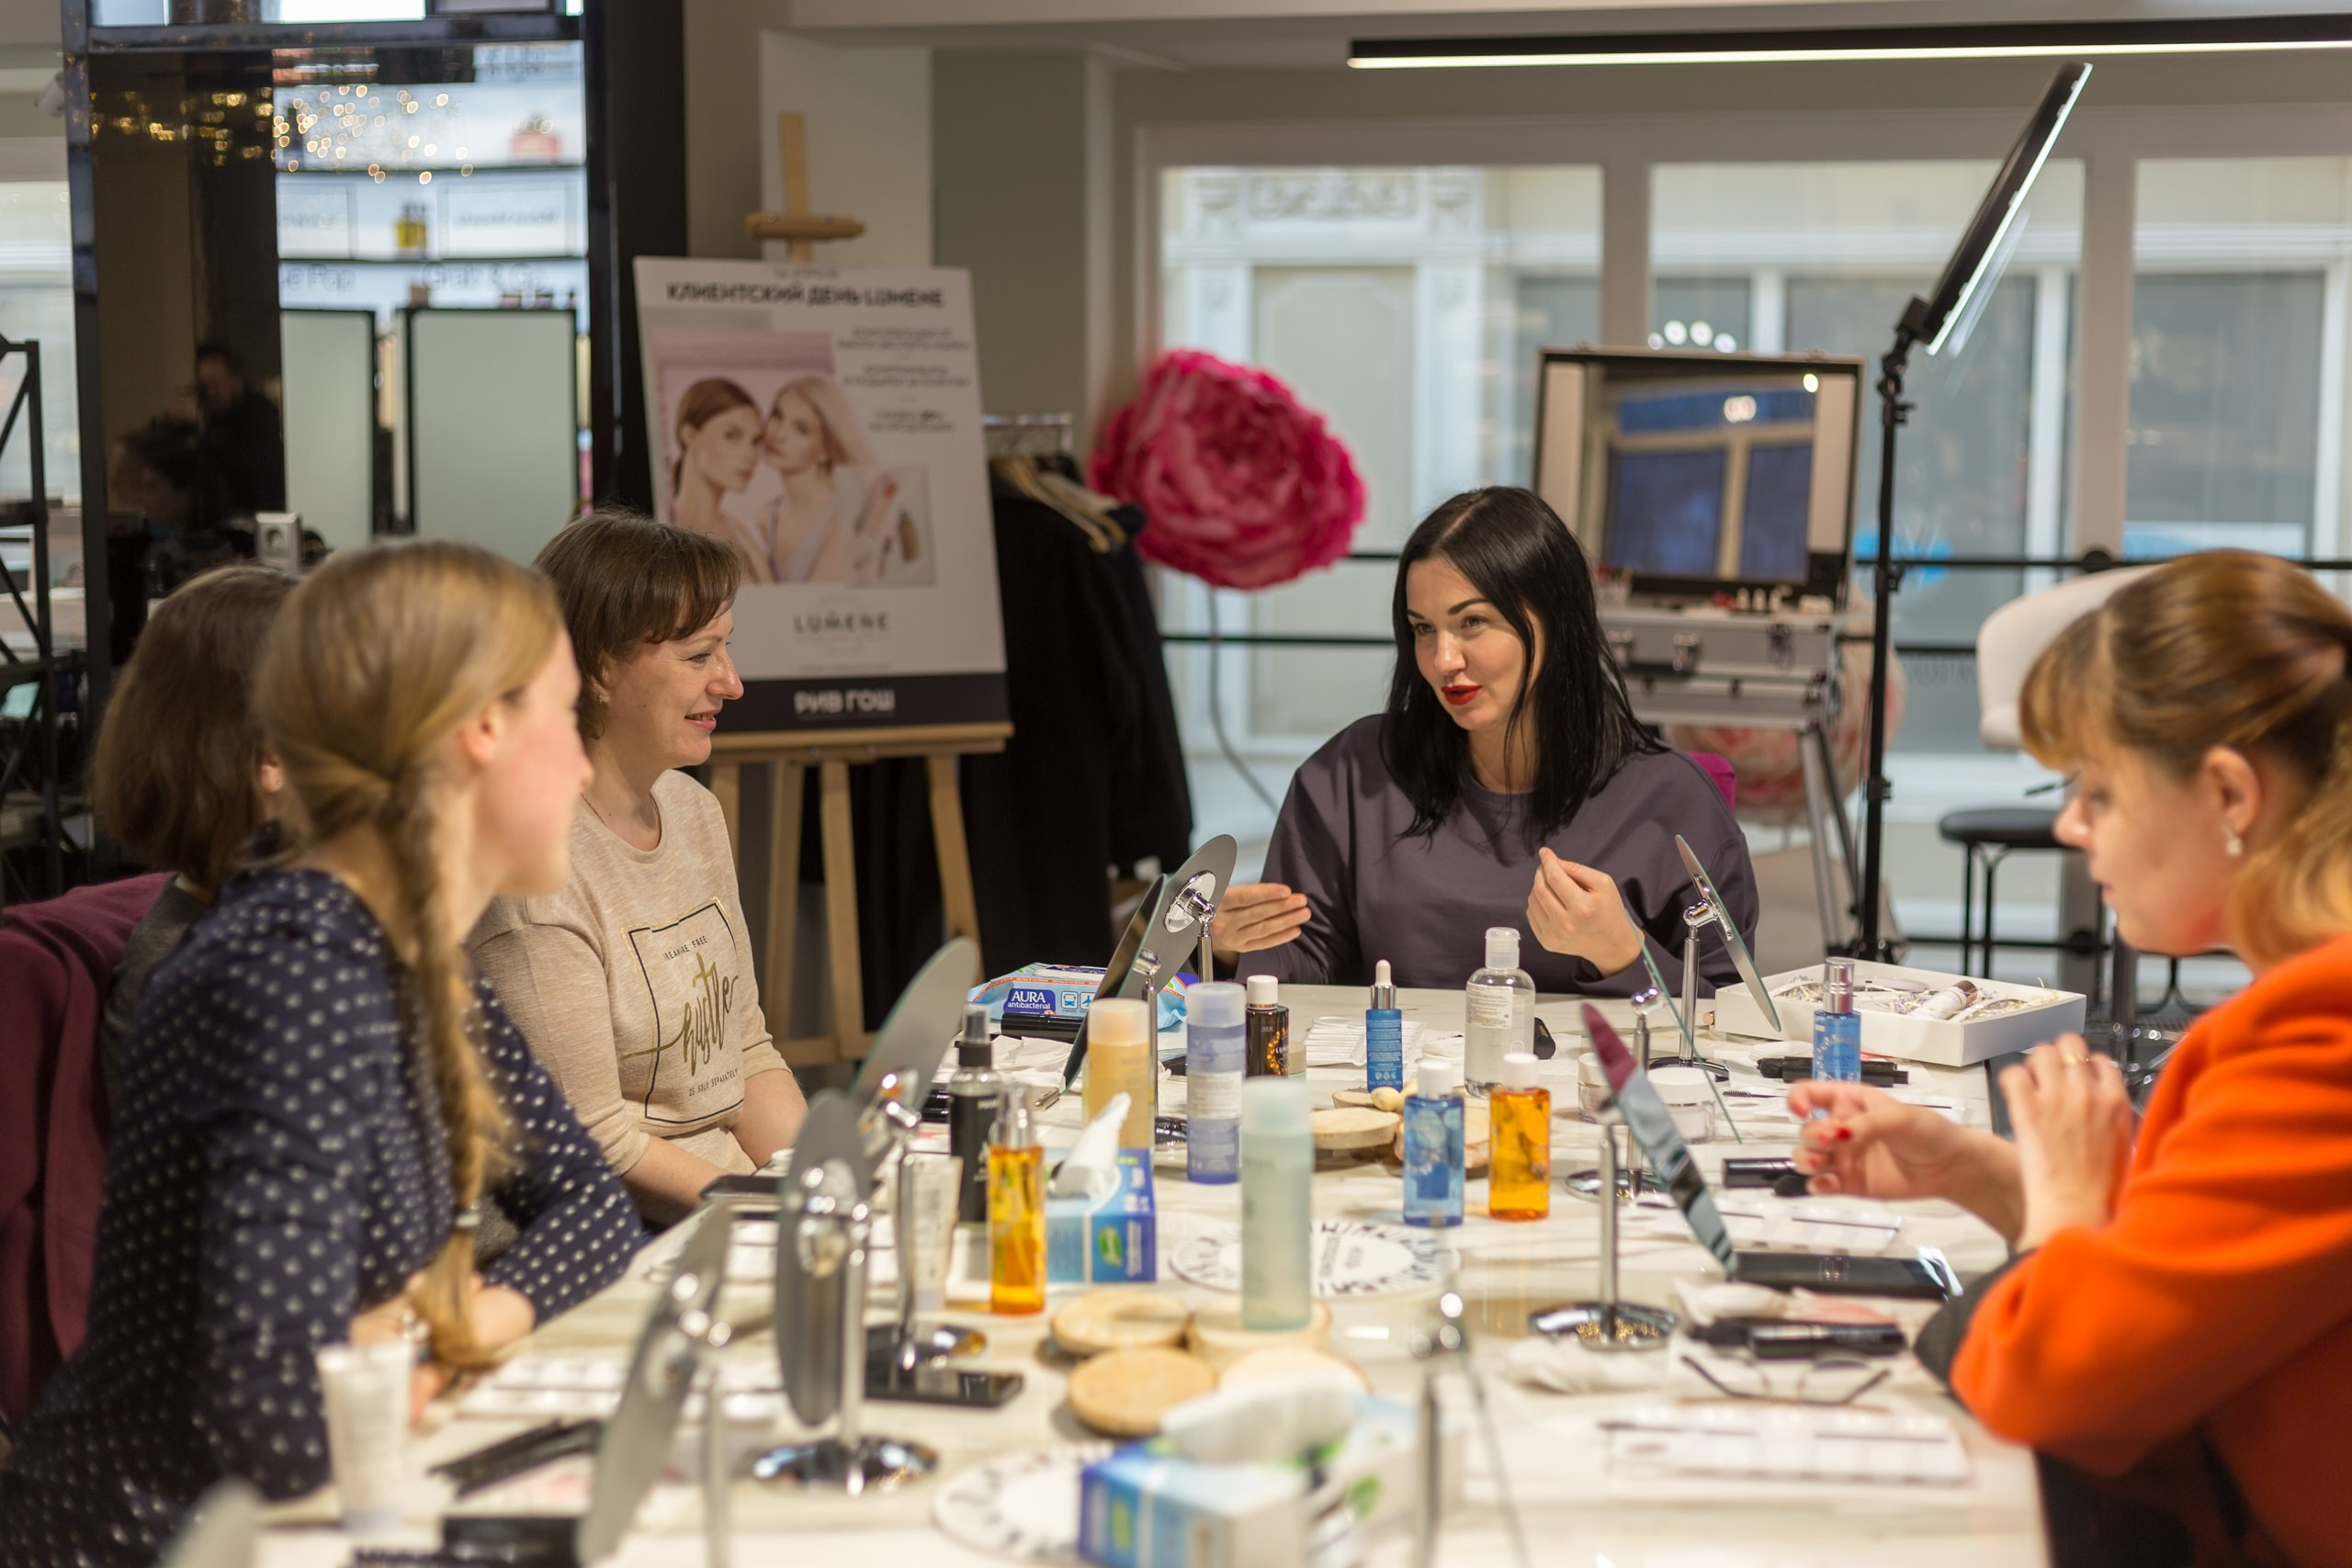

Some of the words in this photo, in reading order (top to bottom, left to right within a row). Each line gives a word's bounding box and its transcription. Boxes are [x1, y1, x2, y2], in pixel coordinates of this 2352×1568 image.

[667, 281, 805, 304] КЛИЕНТСКИЙ
[807, 285, 861, 306] ДЕНЬ
[864, 288, 945, 309] LUMENE
[793, 611, 891, 634] LUMENE
[845, 689, 895, 713] ГОШ
[691, 935, 707, 948] FREE
[1007, 1001, 1051, 1010] antibacterial
[1012, 990, 1046, 1003] AURA
[697, 1081, 709, 1093] SOLD
[711, 1067, 738, 1088] SEPARATELY
